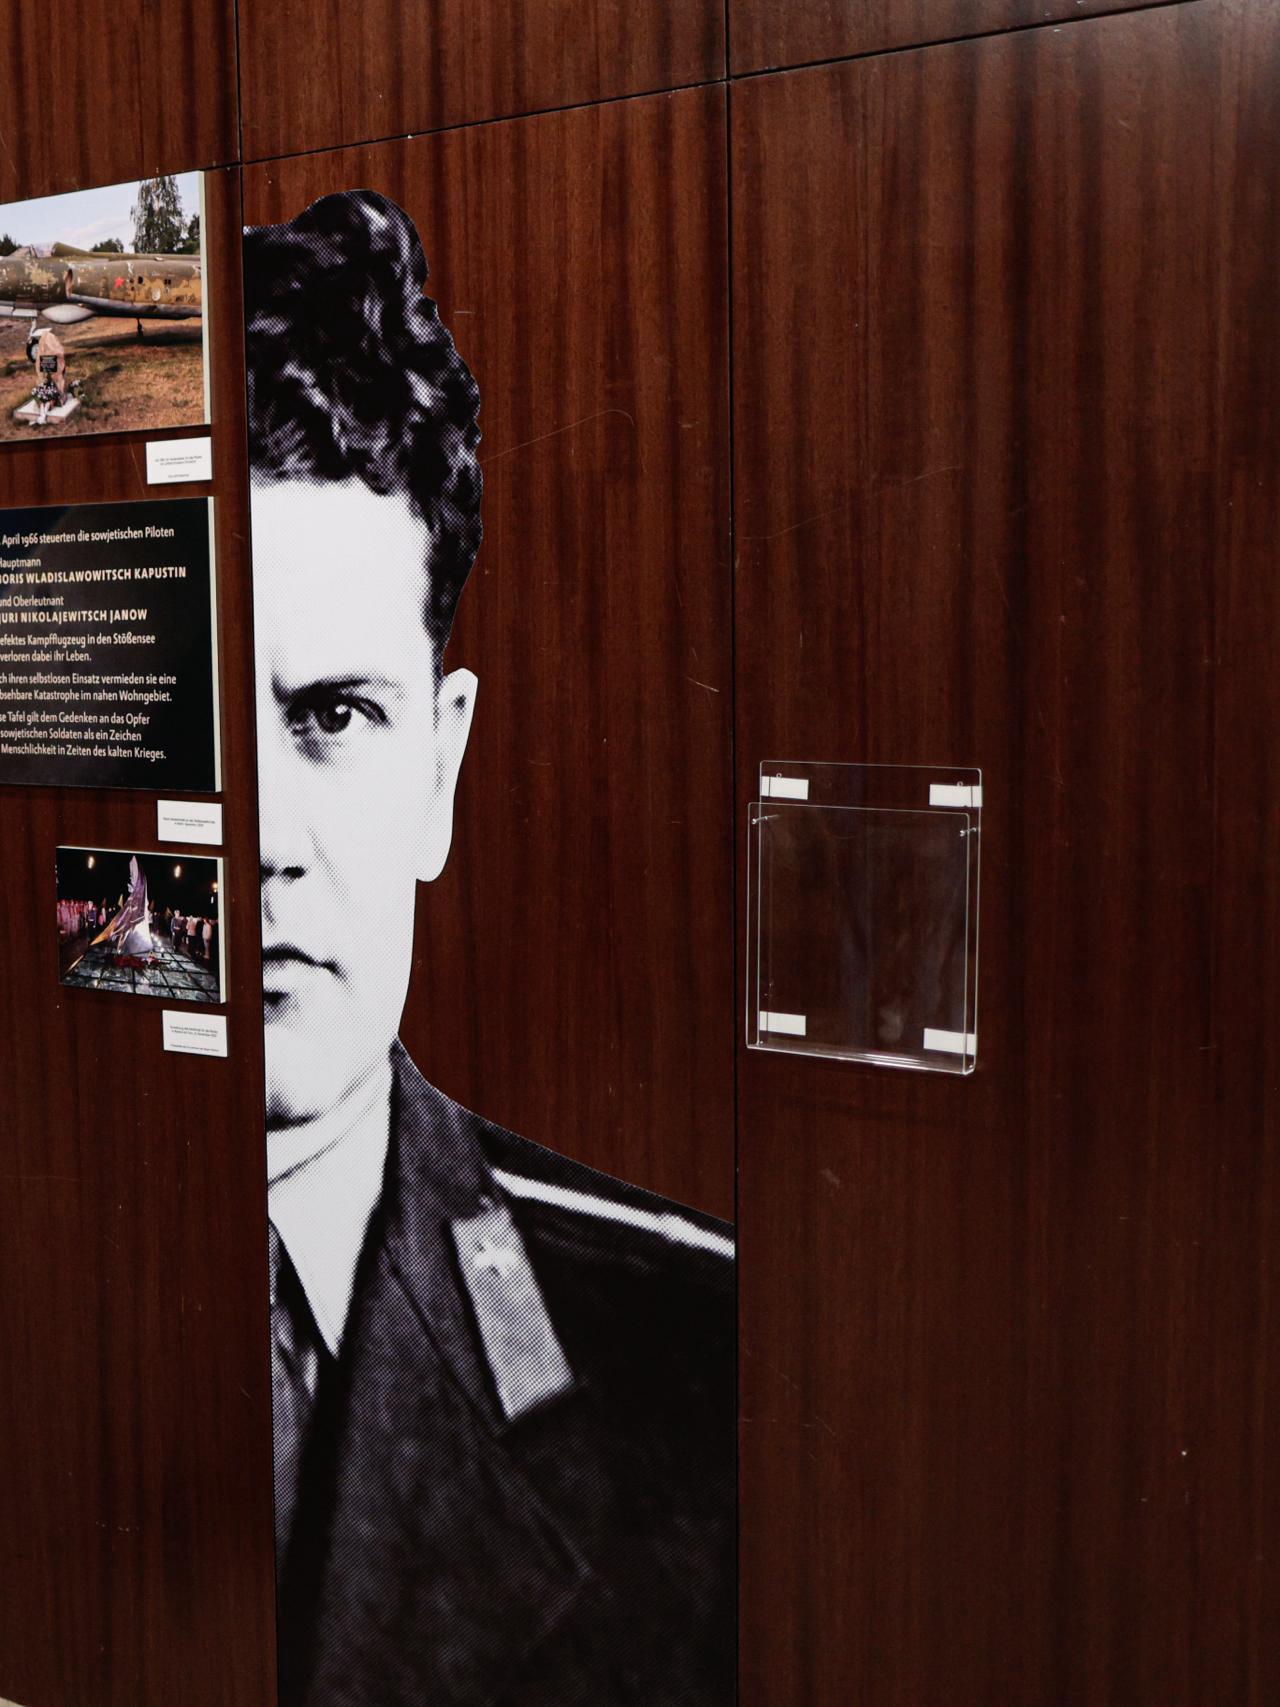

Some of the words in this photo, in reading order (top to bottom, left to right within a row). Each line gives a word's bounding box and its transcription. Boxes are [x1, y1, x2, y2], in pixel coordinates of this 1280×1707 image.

[2, 533, 20, 548] April
[21, 533, 38, 547] 1966
[39, 532, 76, 544] steuerten
[77, 529, 90, 541] die
[91, 526, 143, 543] sowjetischen
[145, 525, 174, 538] Piloten
[26, 568, 131, 583] WLADISLAWOWITSCH
[134, 566, 186, 580] KAPUSTIN
[13, 594, 64, 607] Oberleutnant
[20, 609, 107, 625] NIKOLAJEWITSCH
[109, 608, 148, 624] JANOW
[27, 633, 86, 648] Kampfflugzeug
[87, 634, 95, 645] in
[96, 632, 111, 645] den
[113, 631, 156, 645] Stößensee
[0, 650, 30, 662] verloren
[31, 650, 52, 662] dabei
[53, 649, 64, 661] ihr
[65, 649, 92, 662] Leben.
[8, 672, 28, 684] ihren
[29, 672, 70, 684] selbstlosen
[72, 672, 100, 684] Einsatz
[101, 672, 144, 684] vermieden
[145, 673, 157, 685] sie
[158, 673, 177, 685] eine
[33, 688, 79, 703] Katastrophe
[80, 689, 91, 700] im
[92, 689, 118, 701] nahen
[119, 689, 173, 705] Wohngebiet.
[7, 710, 26, 722] Tafel
[27, 710, 40, 725] gilt
[40, 710, 57, 723] dem
[59, 711, 98, 723] Gedenken
[99, 715, 109, 723] an
[110, 712, 125, 724] das
[125, 712, 150, 728] Opfer
[0, 726, 48, 740] sowjetischen
[49, 727, 82, 739] Soldaten
[83, 728, 95, 740] als
[95, 729, 108, 740] ein
[109, 729, 142, 741] Zeichen
[1, 743, 56, 755] Menschlichkeit
[57, 744, 65, 755] in
[66, 744, 91, 756] Zeiten
[92, 744, 106, 757] des
[107, 745, 132, 757] kalten
[134, 747, 167, 762] Krieges.
